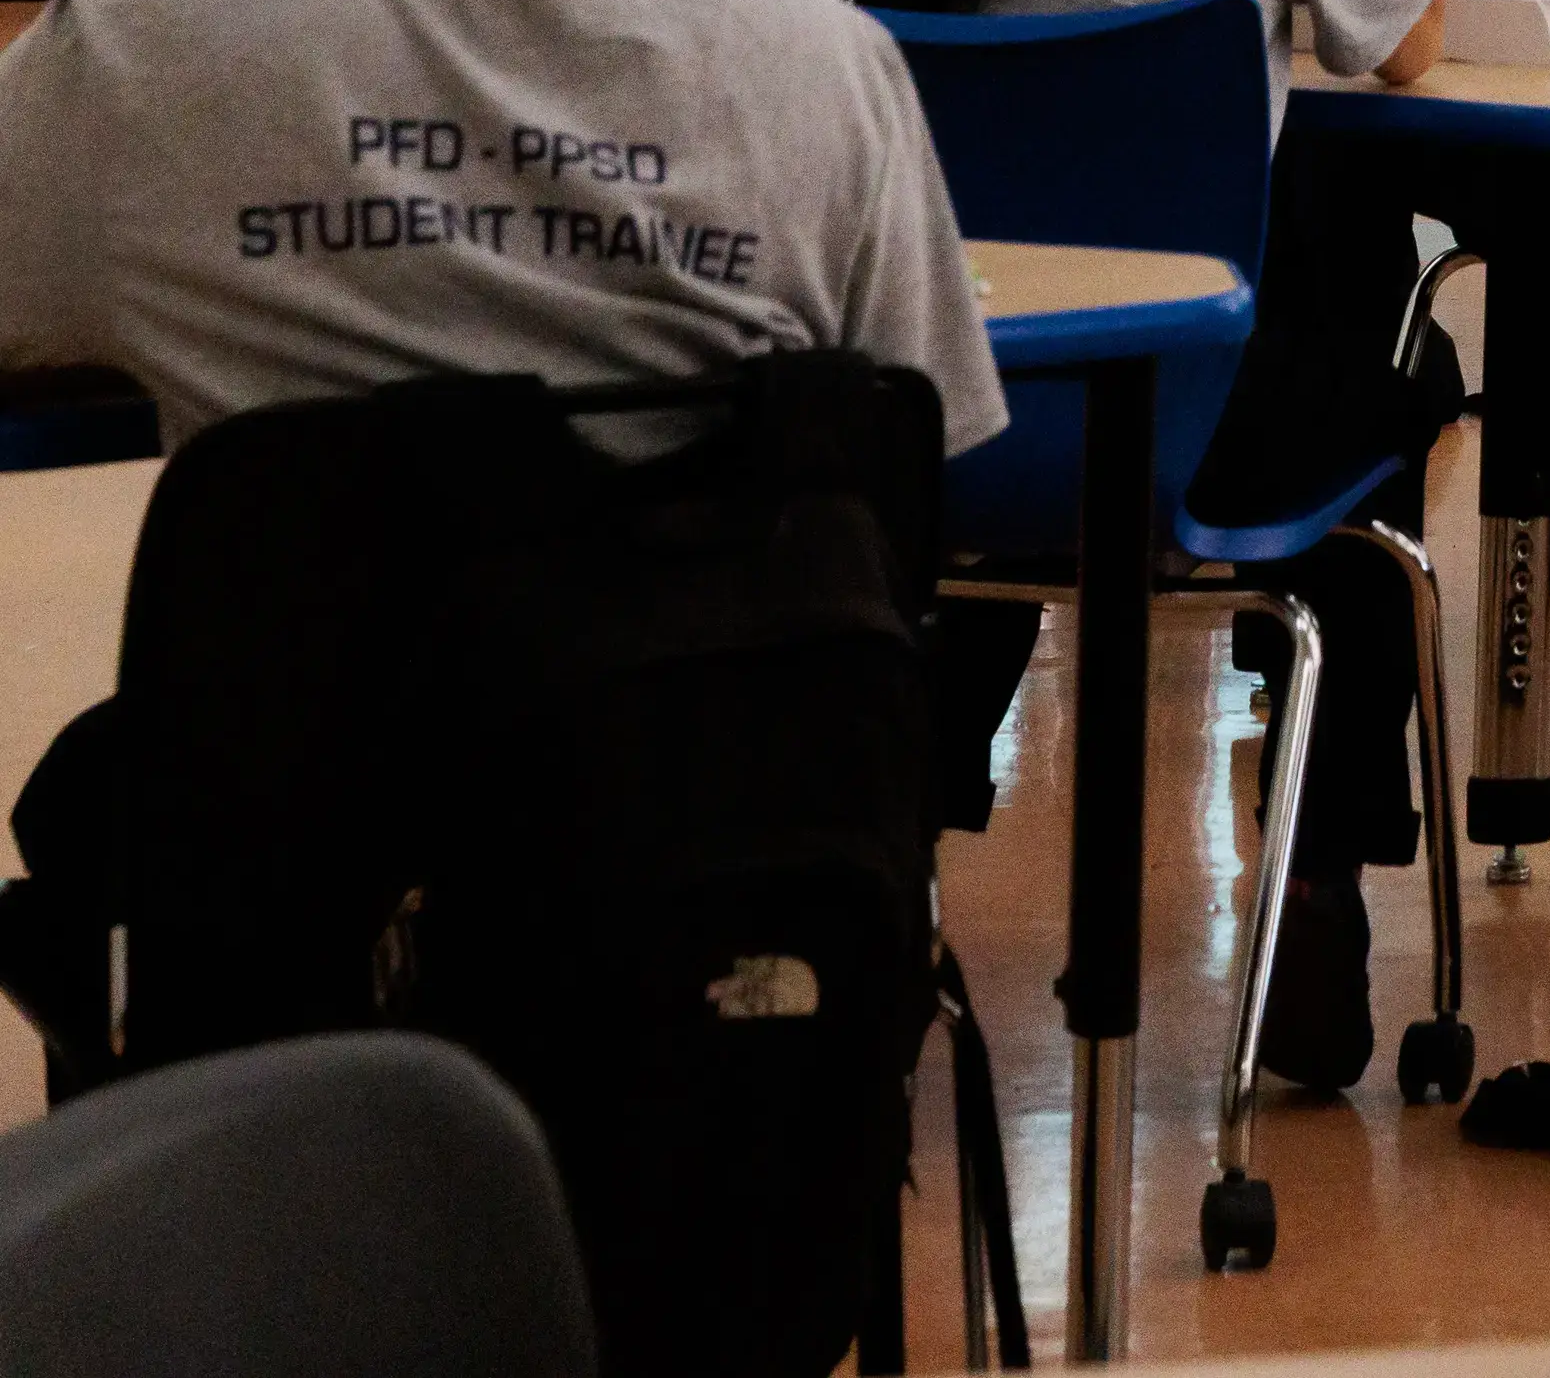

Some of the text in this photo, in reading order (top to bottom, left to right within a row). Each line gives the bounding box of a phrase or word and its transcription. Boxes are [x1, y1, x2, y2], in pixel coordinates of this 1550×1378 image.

[349, 117, 464, 172] PFD
[510, 125, 669, 185] PPSD
[238, 197, 762, 285] STUDENT TRAINEE
